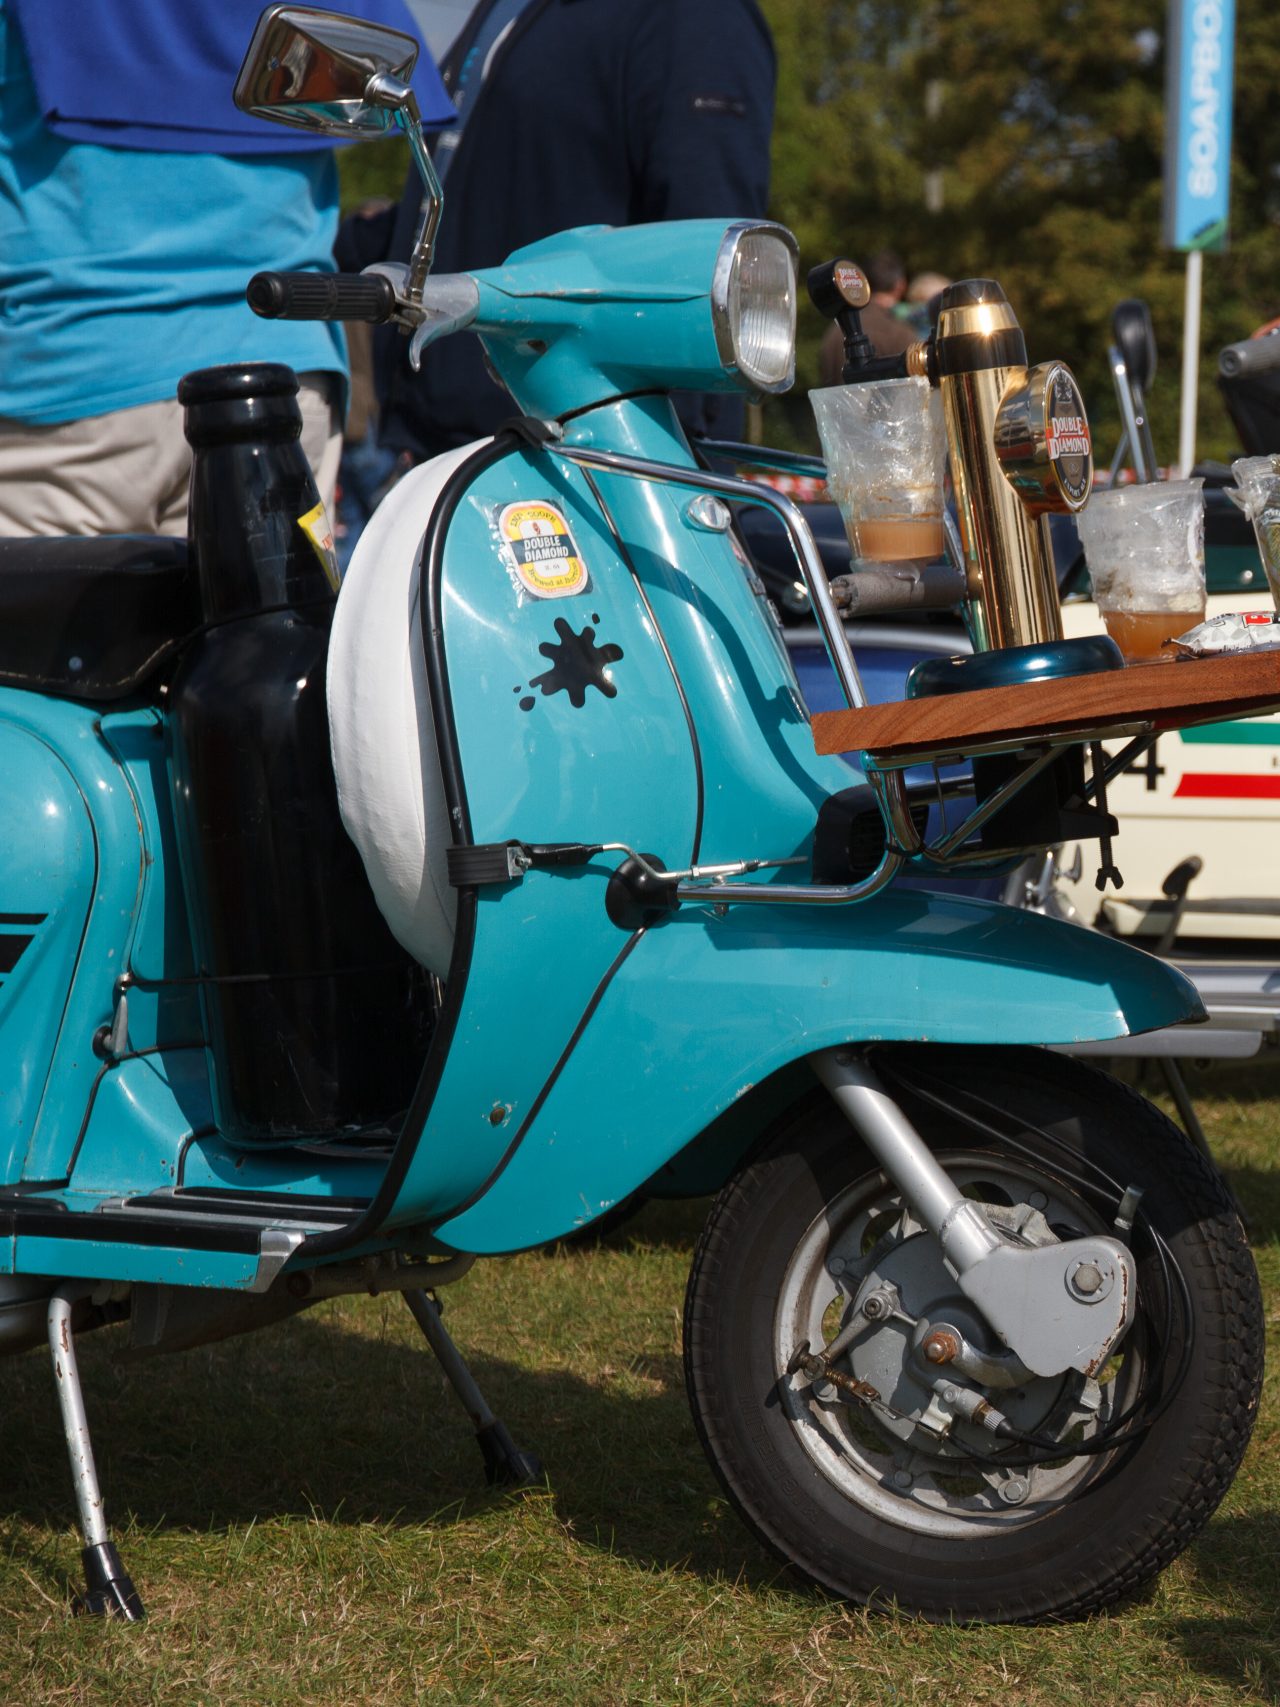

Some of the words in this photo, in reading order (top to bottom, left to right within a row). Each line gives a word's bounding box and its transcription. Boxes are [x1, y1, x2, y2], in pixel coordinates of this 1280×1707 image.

[1187, 0, 1222, 198] SOAPBO
[1051, 417, 1084, 438] DOUBLE
[1049, 437, 1089, 460] DIAMOND
[524, 535, 561, 550] DOUBLE
[524, 546, 569, 562] DIAMOND
